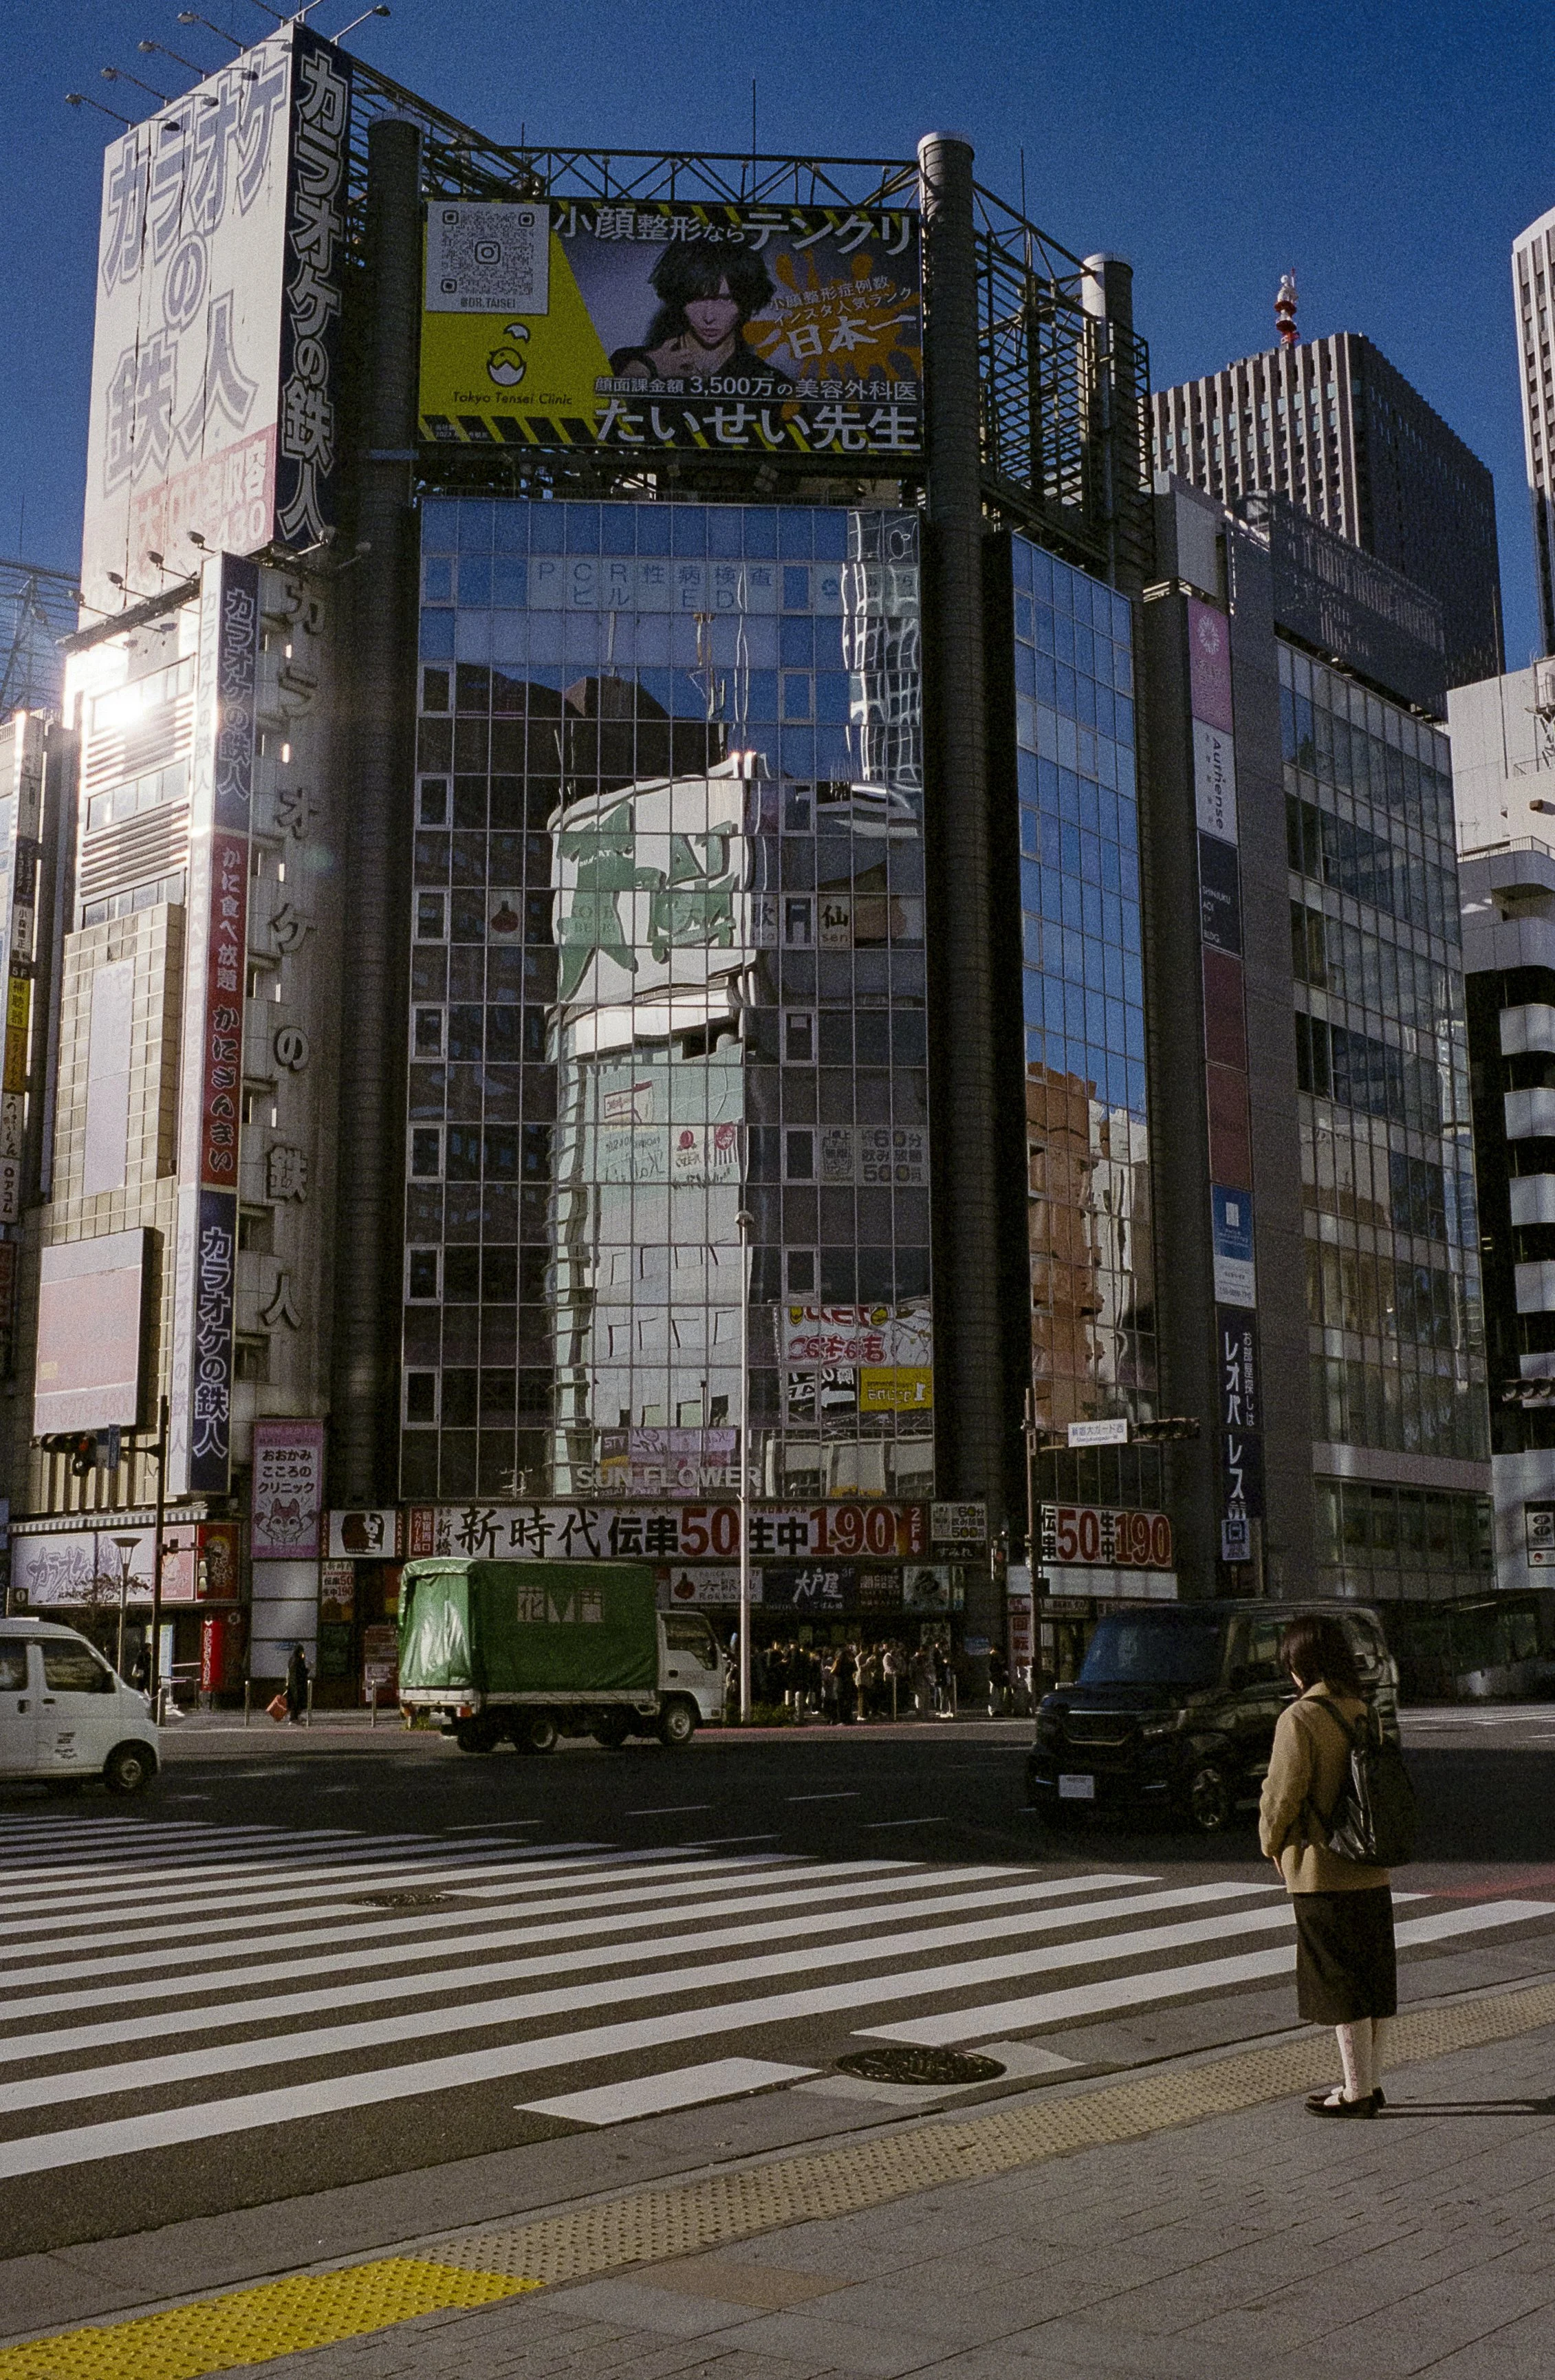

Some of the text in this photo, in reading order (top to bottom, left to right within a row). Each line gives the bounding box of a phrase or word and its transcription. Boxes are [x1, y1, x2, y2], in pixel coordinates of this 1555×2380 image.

[103, 47, 289, 296] カラオケ
[164, 230, 208, 331] の
[279, 48, 348, 544] カラオケの鉄人
[769, 275, 890, 311] 小顔整形症例数
[774, 287, 912, 327] インスタ人気ランク
[787, 314, 917, 359] 日本一
[102, 290, 258, 498] 鉄人
[453, 391, 573, 406] Tokyo Tensei Clinic
[594, 396, 922, 451] たいせい先生
[539, 562, 772, 586] PCR性病検査
[682, 589, 735, 609] ED
[217, 587, 254, 801] カラオケの鉄人
[1212, 737, 1226, 830] Authense
[216, 846, 241, 992] かに食べ放題
[208, 1006, 239, 1173] かにざんまい
[874, 1130, 922, 1147] 60分
[193, 1226, 232, 1458] カラオケの鉄人
[262, 1449, 312, 1462] おおかみ
[262, 1466, 312, 1478] こころの
[576, 1466, 761, 1489] SUN FLOWER
[258, 1482, 315, 1494] クリニック
[454, 1506, 600, 1559] 新時代
[1042, 1507, 1056, 1559] 伝串
[1058, 1508, 1099, 1561] 50
[1115, 1512, 1171, 1566] 190
[792, 1567, 844, 1604] 大戸屋
[841, 1568, 856, 1578] 3F
